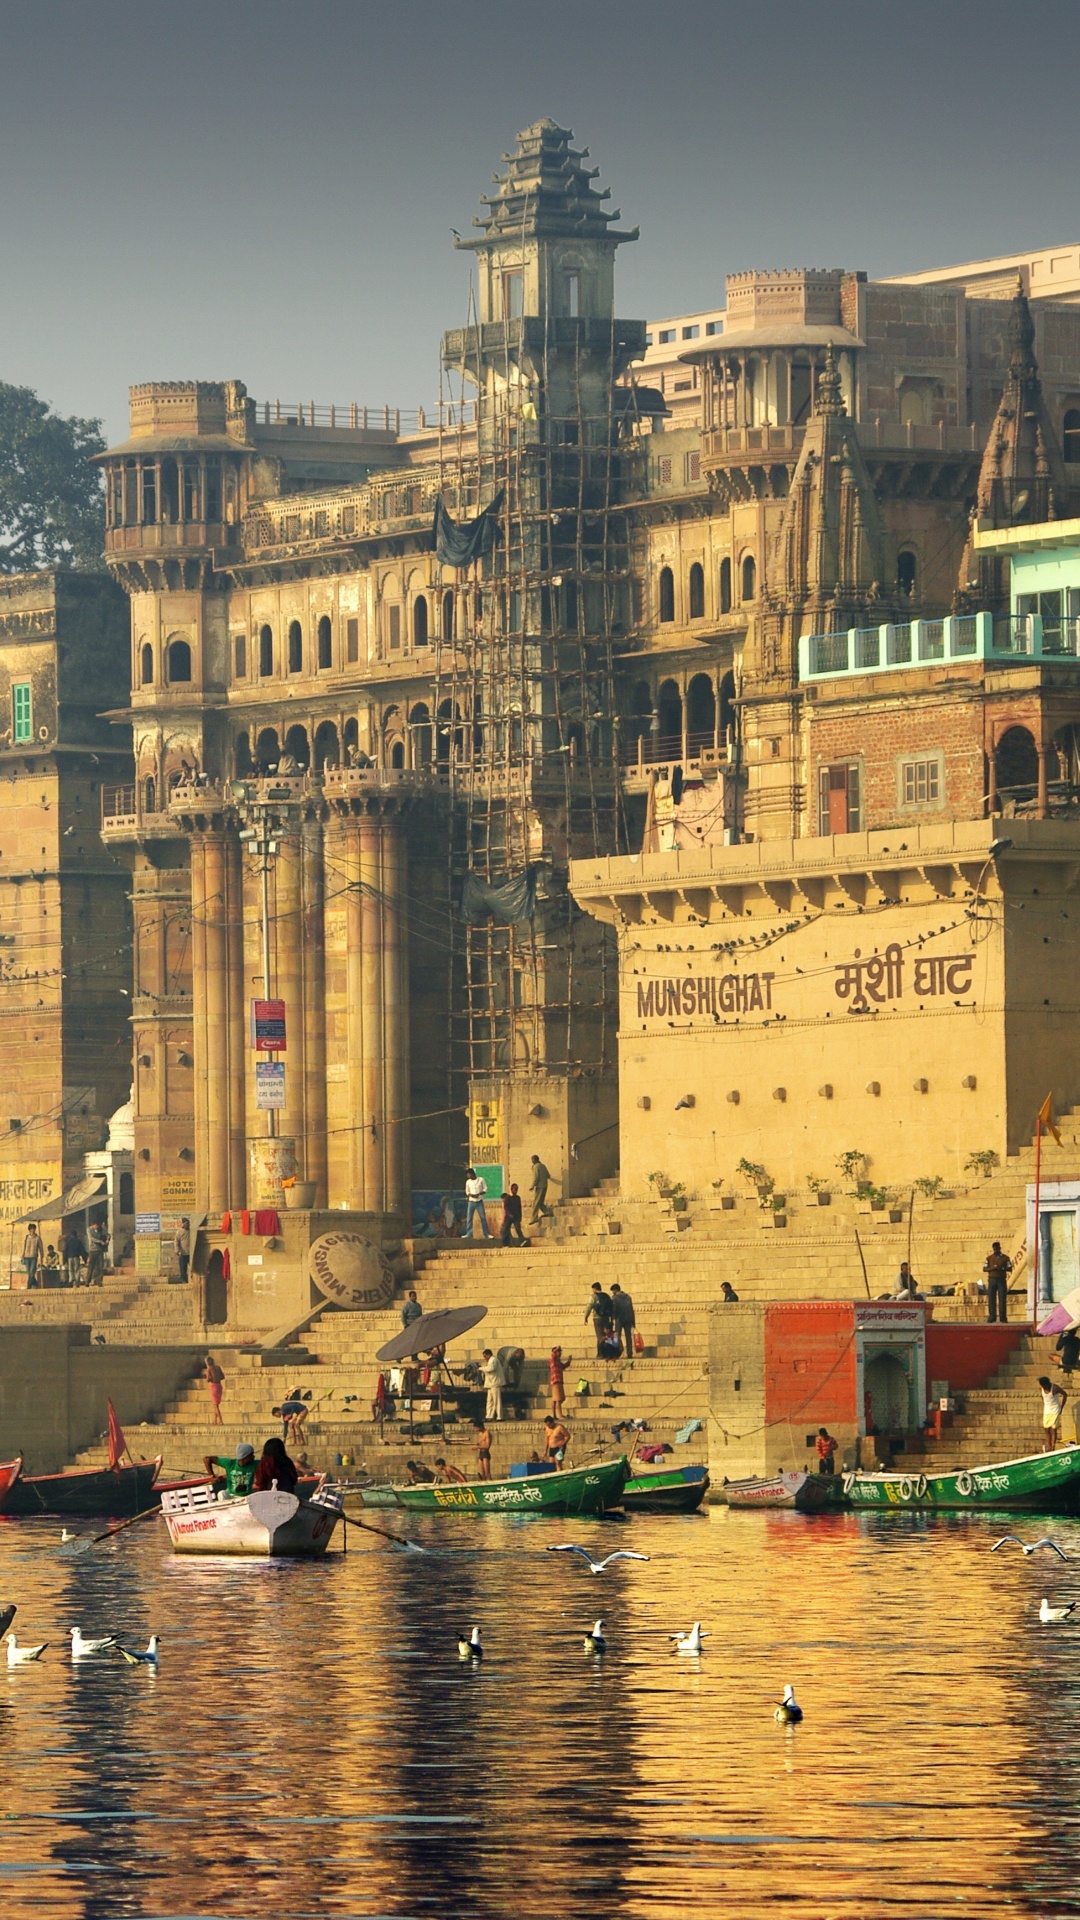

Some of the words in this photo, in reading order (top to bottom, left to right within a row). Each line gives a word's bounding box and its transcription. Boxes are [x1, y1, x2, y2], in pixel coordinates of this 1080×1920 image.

[834, 943, 905, 1015] मुंशी
[914, 953, 977, 996] घाट
[476, 1117, 498, 1139] घाट
[27, 1178, 54, 1199] घाट
